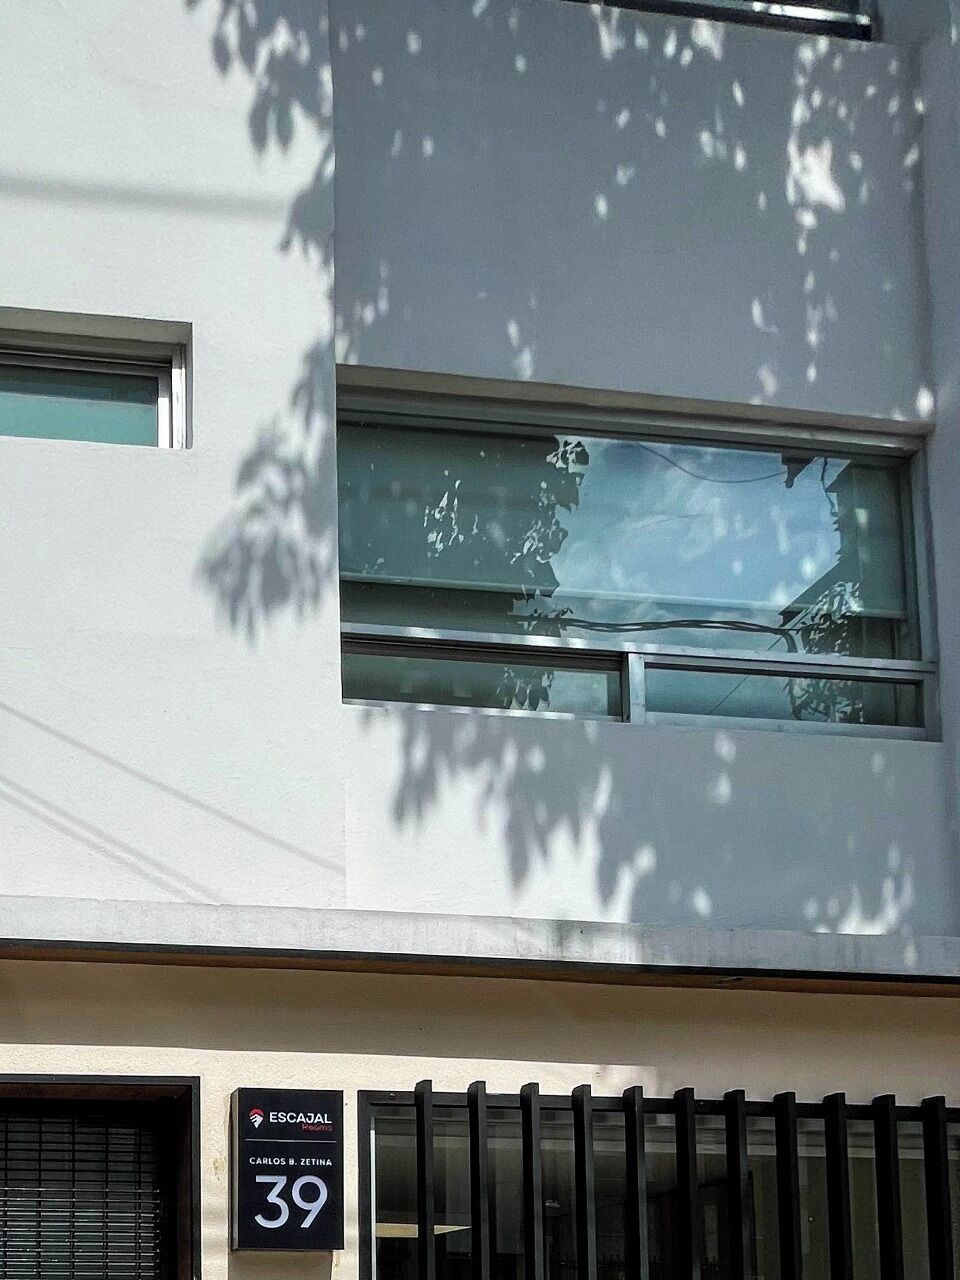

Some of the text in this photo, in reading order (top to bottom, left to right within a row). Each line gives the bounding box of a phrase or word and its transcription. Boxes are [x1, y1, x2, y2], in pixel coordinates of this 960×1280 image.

[269, 1112, 332, 1124] ESCAJAL
[249, 1157, 286, 1165] CARLOS
[300, 1158, 332, 1167] ZETINA
[254, 1175, 328, 1229] 39
